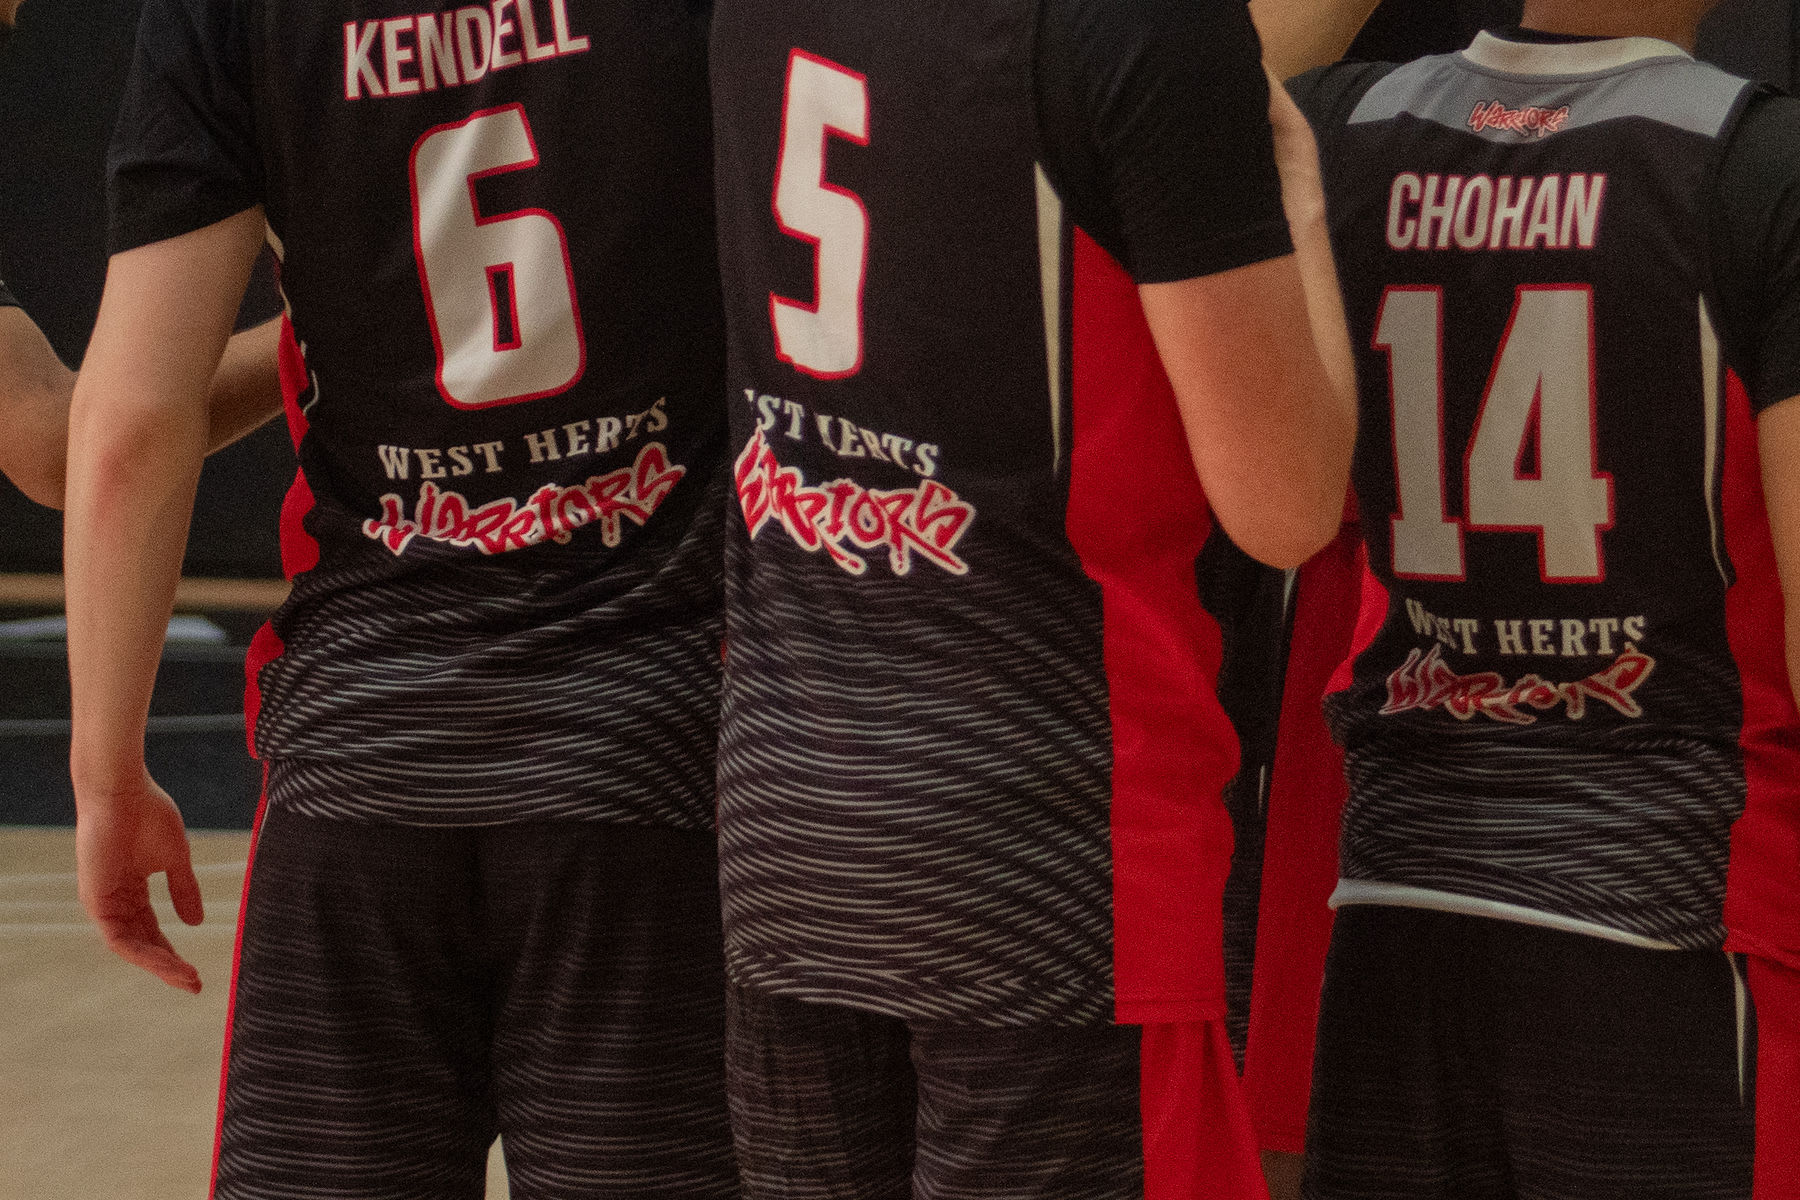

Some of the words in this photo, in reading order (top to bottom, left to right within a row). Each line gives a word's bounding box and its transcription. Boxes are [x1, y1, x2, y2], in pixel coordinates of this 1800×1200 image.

[408, 102, 588, 411] 6
[770, 48, 869, 381] 5
[1386, 171, 1607, 252] CHOHAN
[378, 440, 504, 480] WEST
[523, 396, 670, 463] HERTS
[1371, 283, 1615, 585] 14
[1494, 614, 1646, 657] HERTS
